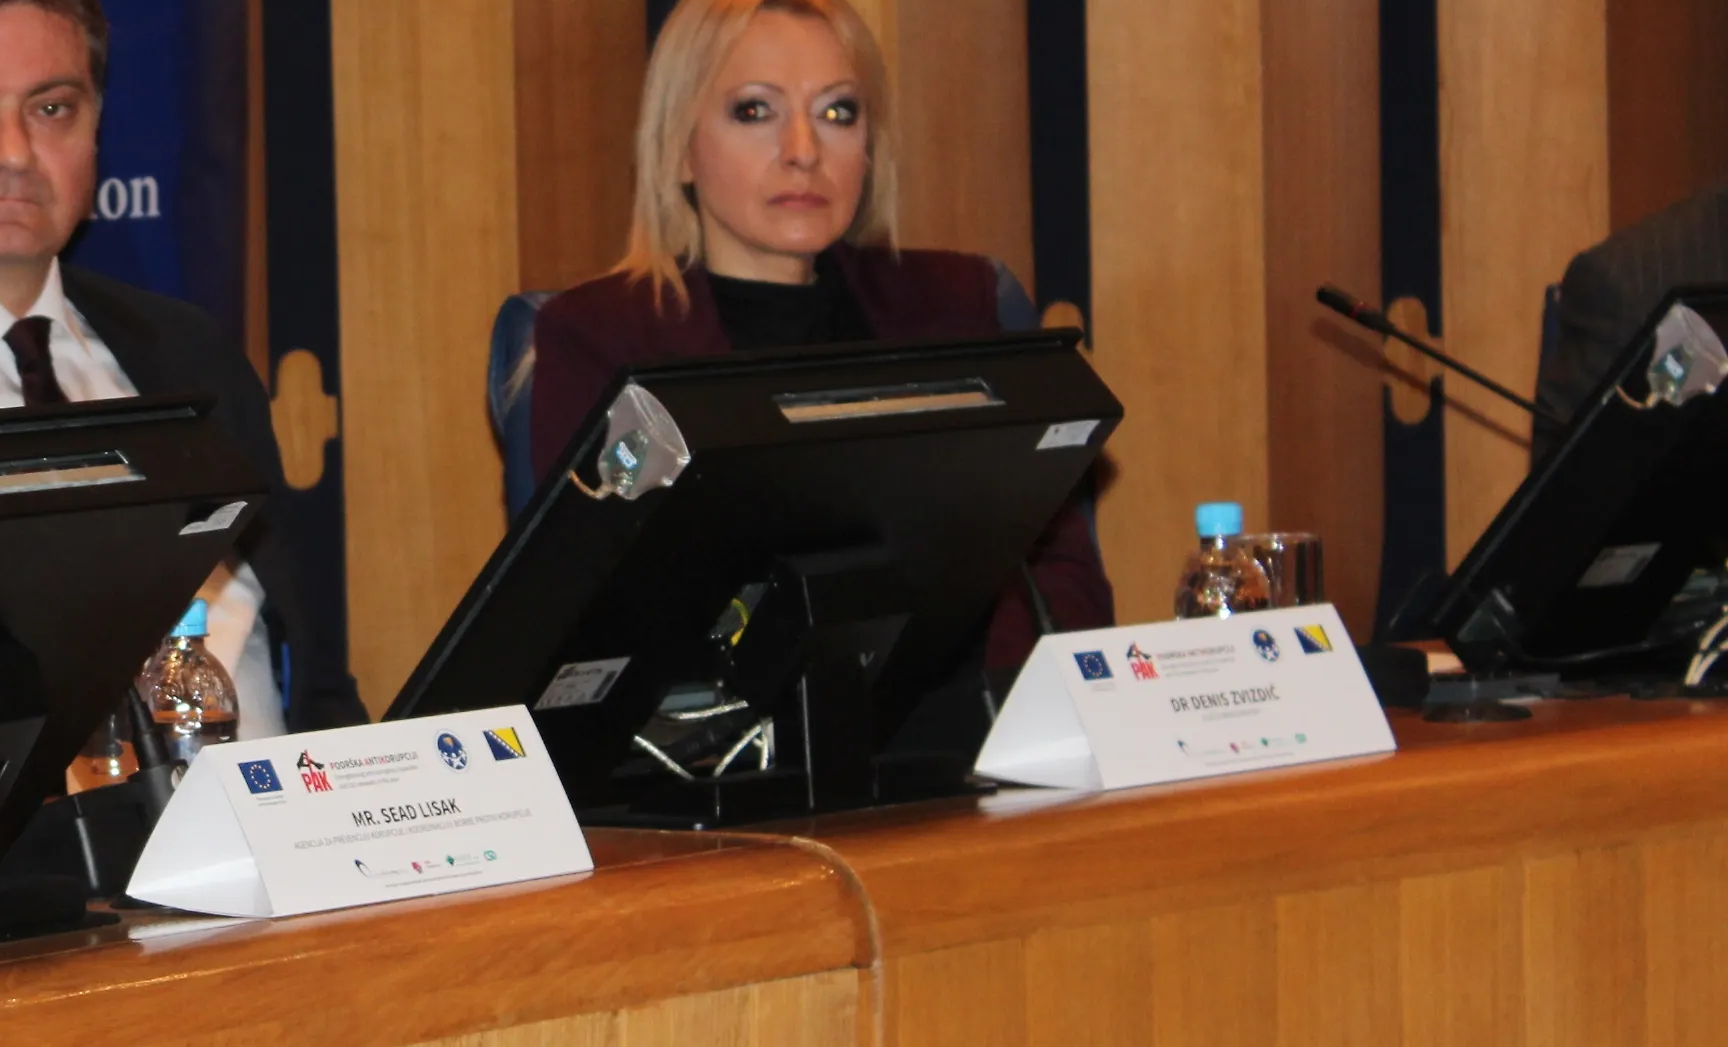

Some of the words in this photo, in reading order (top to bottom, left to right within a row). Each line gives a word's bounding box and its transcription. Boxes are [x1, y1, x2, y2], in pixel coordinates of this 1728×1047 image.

[89, 175, 161, 220] on
[1170, 696, 1190, 713] DR
[1190, 692, 1230, 710] DENIS
[1231, 682, 1280, 706] ZVIZDIĆ
[302, 771, 334, 794] PAK
[351, 809, 381, 828] MR.
[381, 804, 417, 824] SEAD
[417, 798, 462, 819] LISAK
